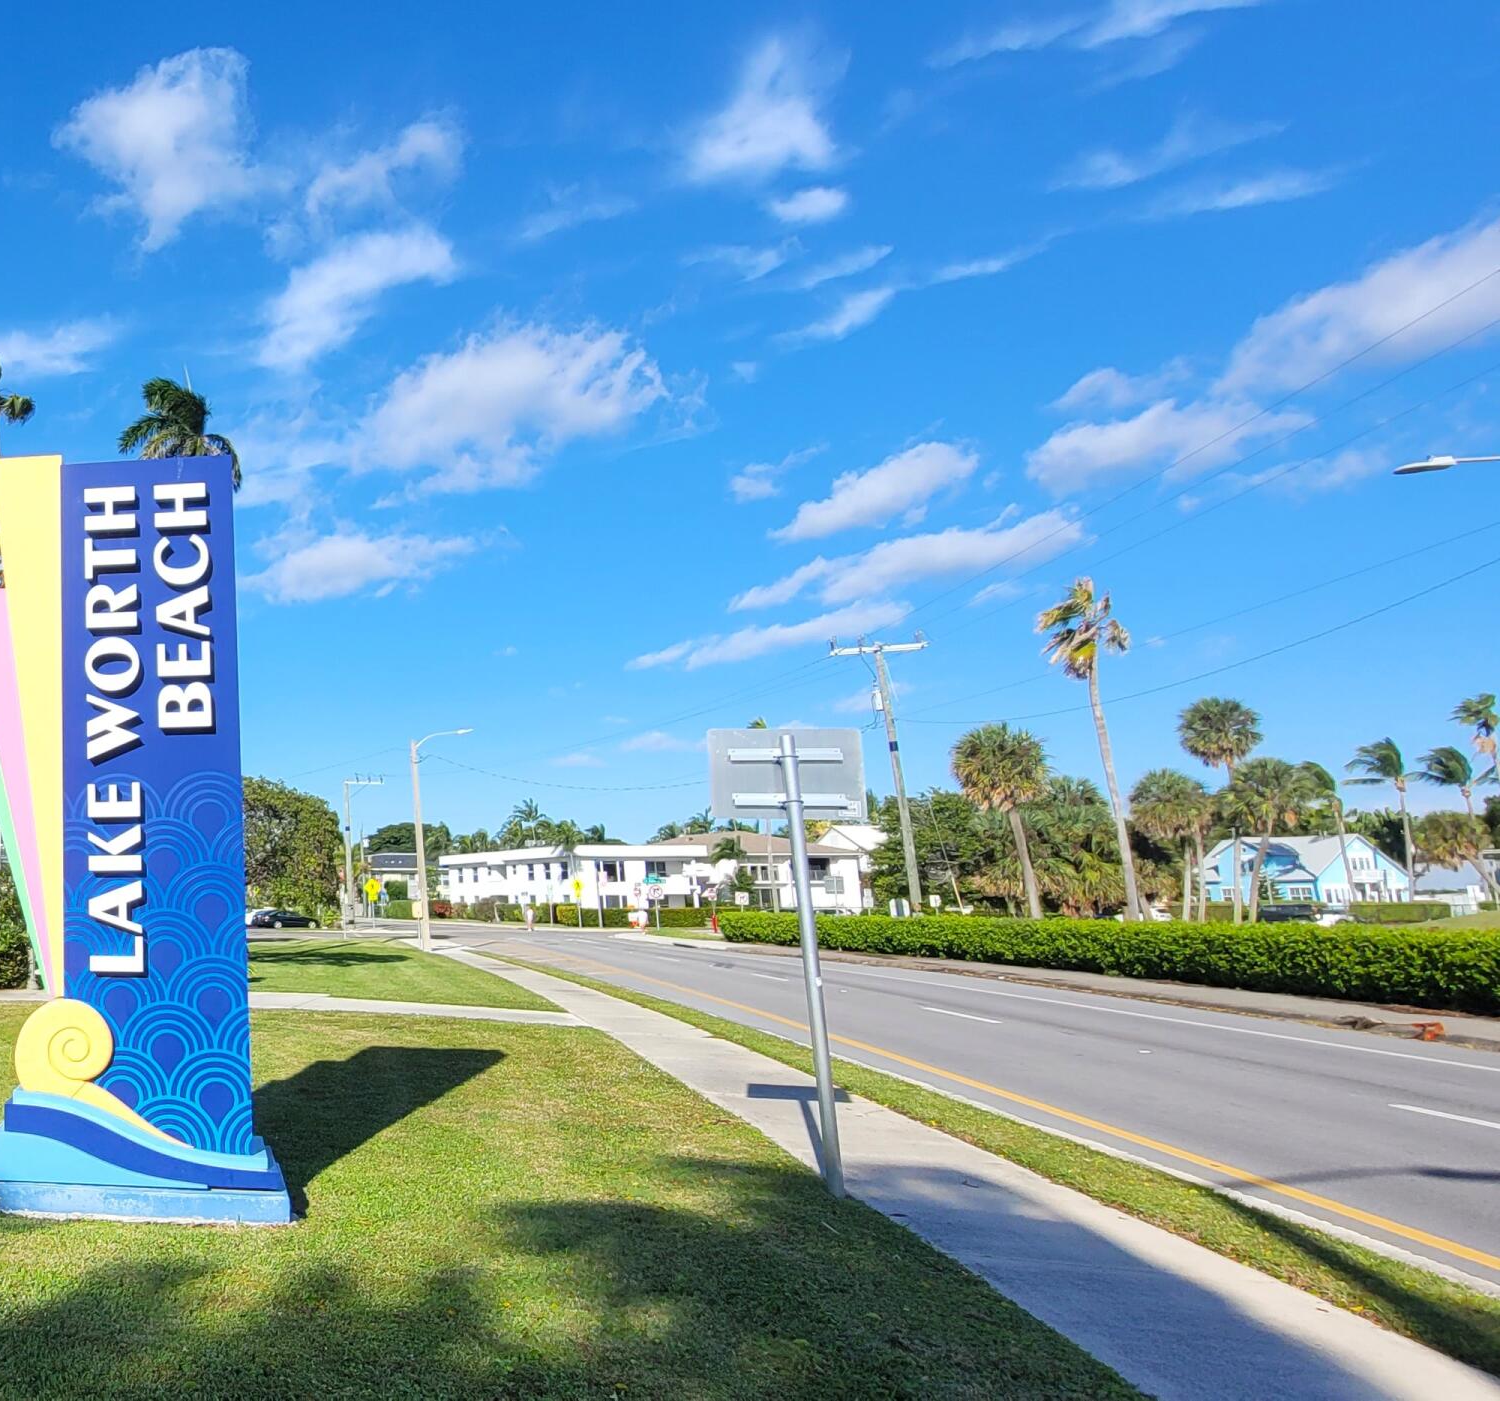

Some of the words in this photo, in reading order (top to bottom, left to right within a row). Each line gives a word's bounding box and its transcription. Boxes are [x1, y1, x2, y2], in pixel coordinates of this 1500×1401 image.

[83, 485, 140, 762] WORTH
[152, 482, 213, 730] BEACH
[86, 781, 144, 974] LAKE
